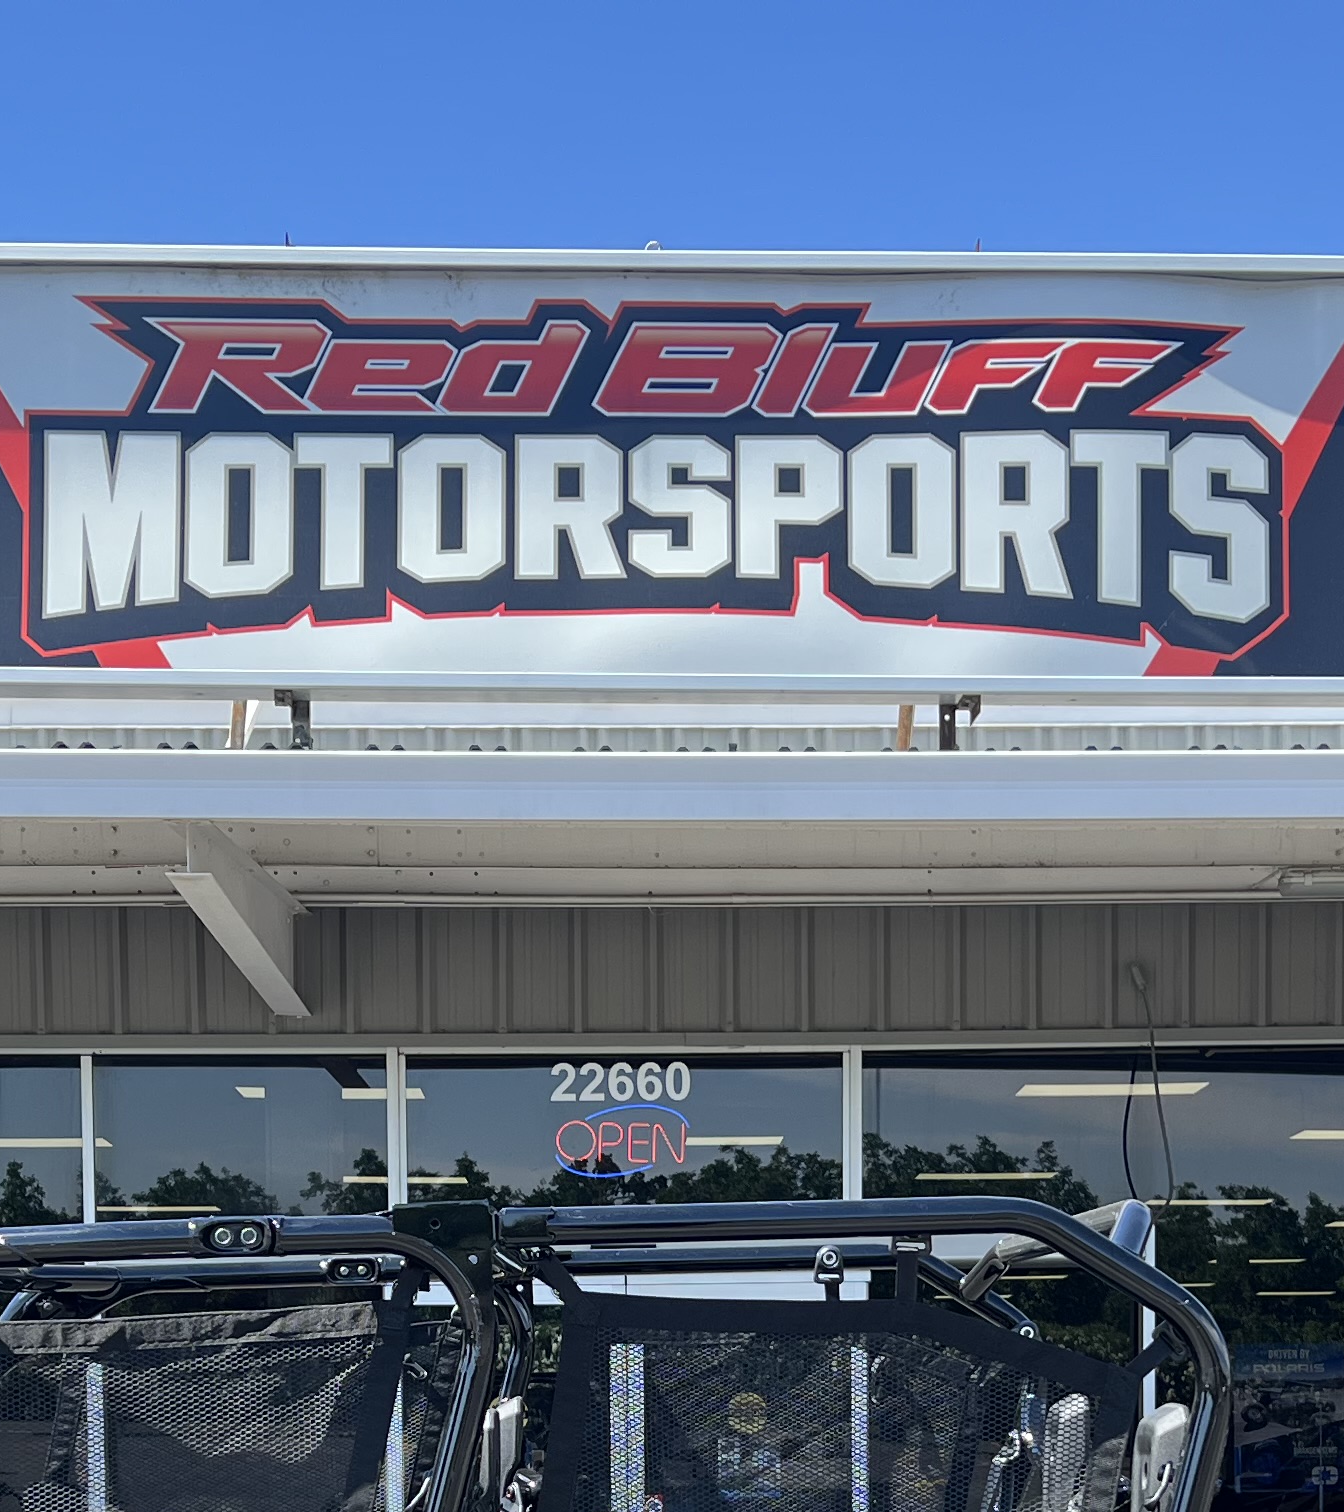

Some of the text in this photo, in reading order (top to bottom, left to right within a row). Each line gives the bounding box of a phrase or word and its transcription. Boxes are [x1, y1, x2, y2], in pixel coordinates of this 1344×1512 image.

[148, 316, 592, 415] Red
[42, 429, 1271, 623] MOTORSPORTS
[550, 1061, 691, 1102] 22660
[556, 1119, 687, 1164] OPEN
[1252, 1363, 1325, 1374] POLARIS
